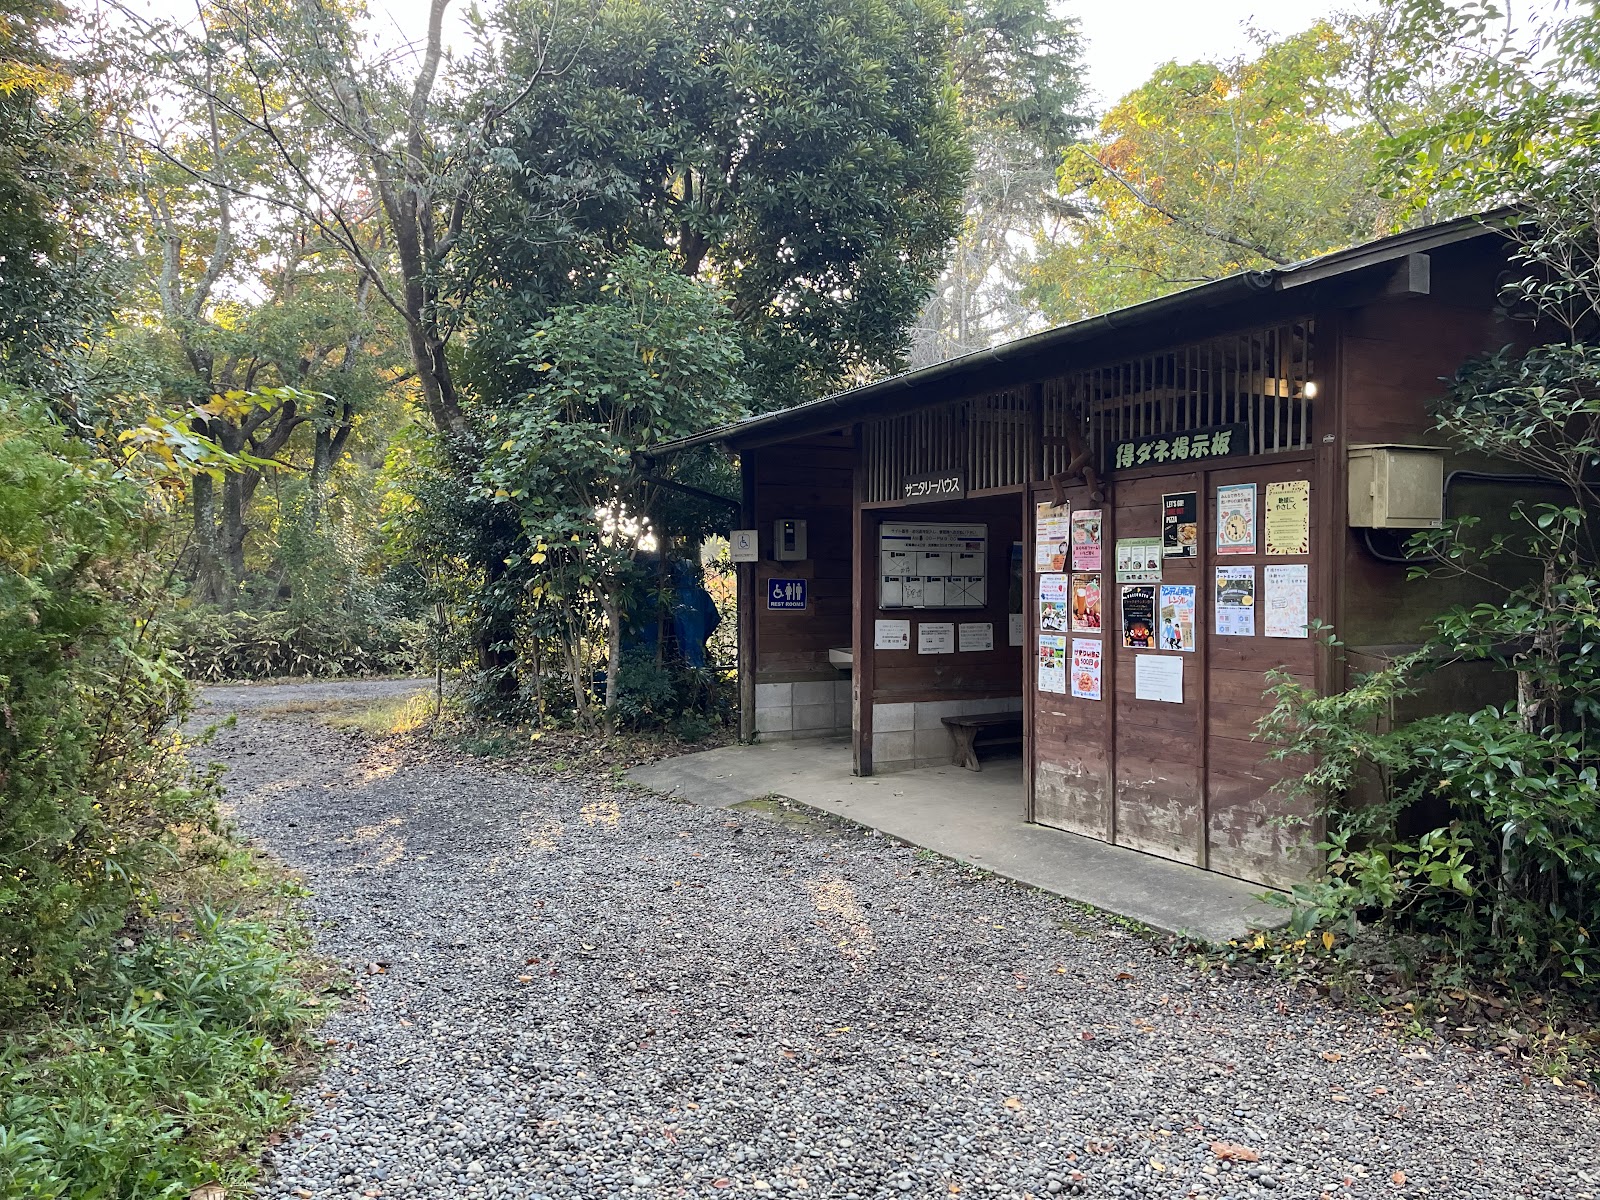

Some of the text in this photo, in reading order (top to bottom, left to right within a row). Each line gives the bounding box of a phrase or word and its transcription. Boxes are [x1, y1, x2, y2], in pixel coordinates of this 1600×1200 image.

[1115, 430, 1232, 468] 得ダネ掲示板
[905, 477, 960, 497] サニタリーハウス
[1166, 500, 1177, 508] LET'S
[1278, 496, 1295, 504] 地球に
[1276, 503, 1297, 511] やさしく
[1166, 515, 1178, 523] PIZZA
